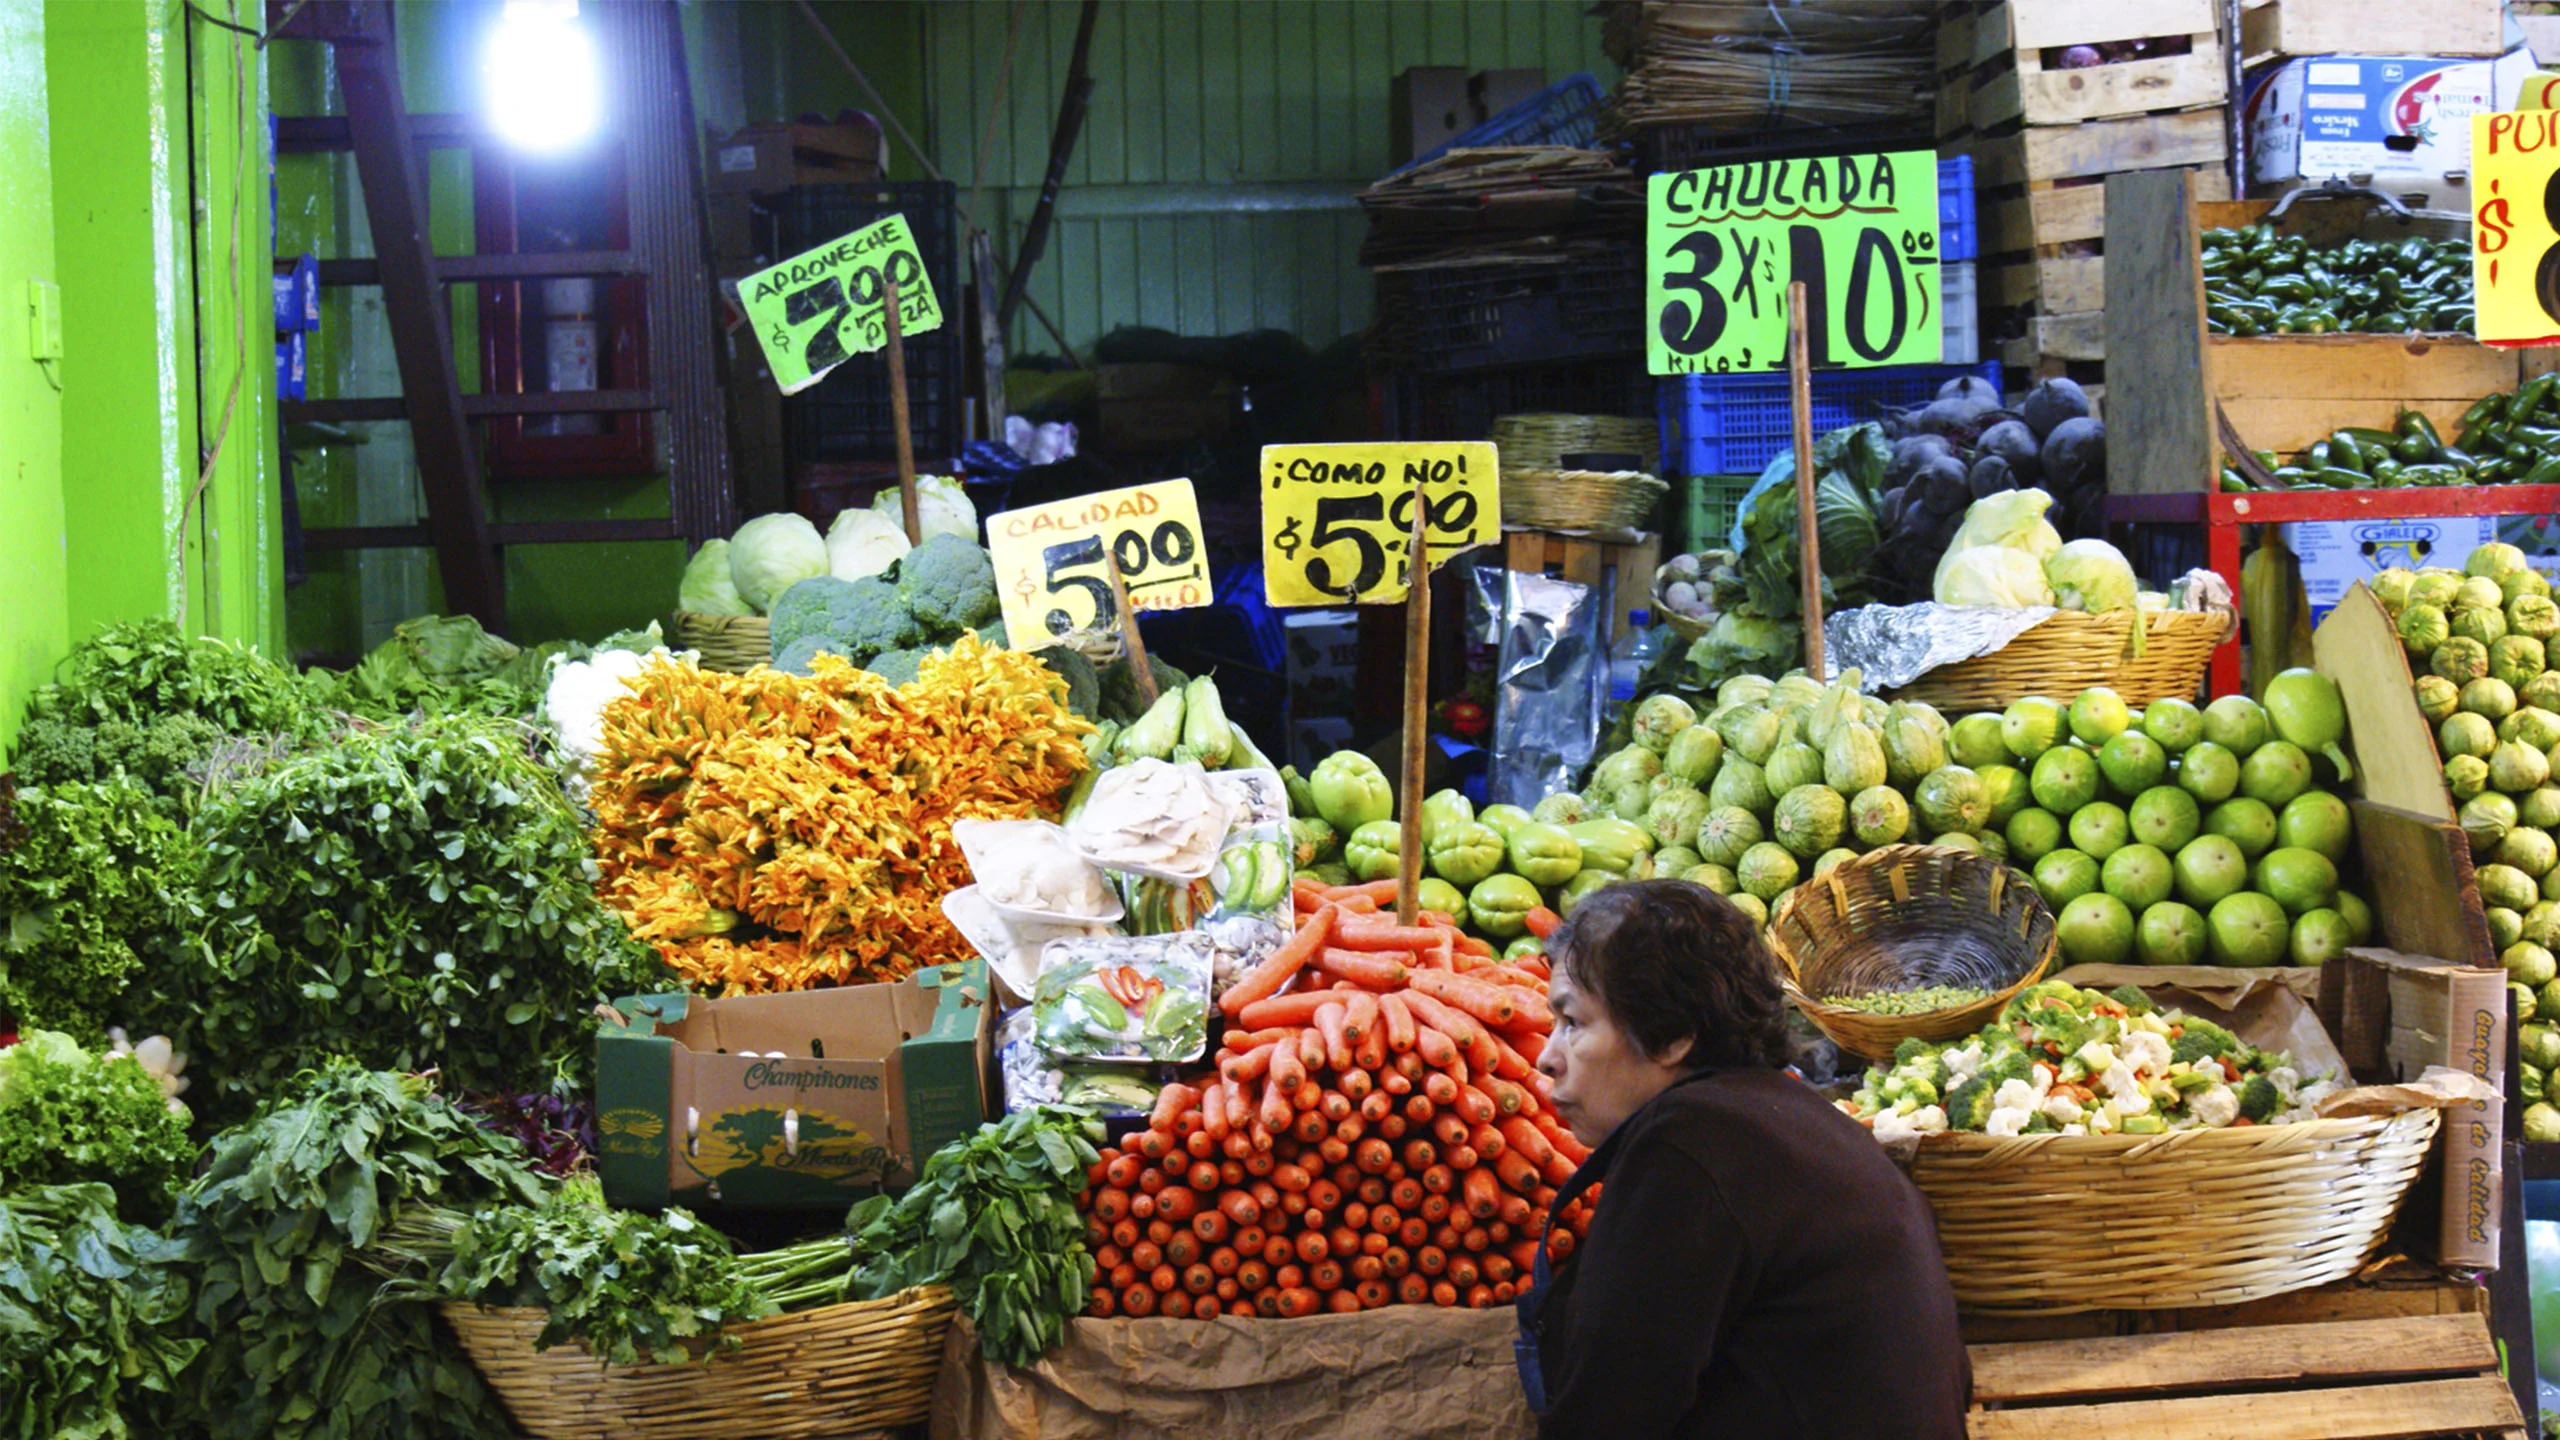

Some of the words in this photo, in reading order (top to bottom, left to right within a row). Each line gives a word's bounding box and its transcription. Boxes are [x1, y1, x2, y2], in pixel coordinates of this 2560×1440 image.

[2312, 114, 2360, 128] Mexico
[2436, 108, 2481, 121] resh
[2319, 127, 2352, 138] From
[1666, 154, 1896, 213] CHULADA
[754, 222, 902, 303] APROVECHE
[1404, 454, 1468, 486] NO!
[1006, 491, 1159, 538] CALIDAD
[743, 1058, 880, 1093] Champiñones
[2470, 1120, 2491, 1150] de
[2467, 1157, 2491, 1244] Calidad
